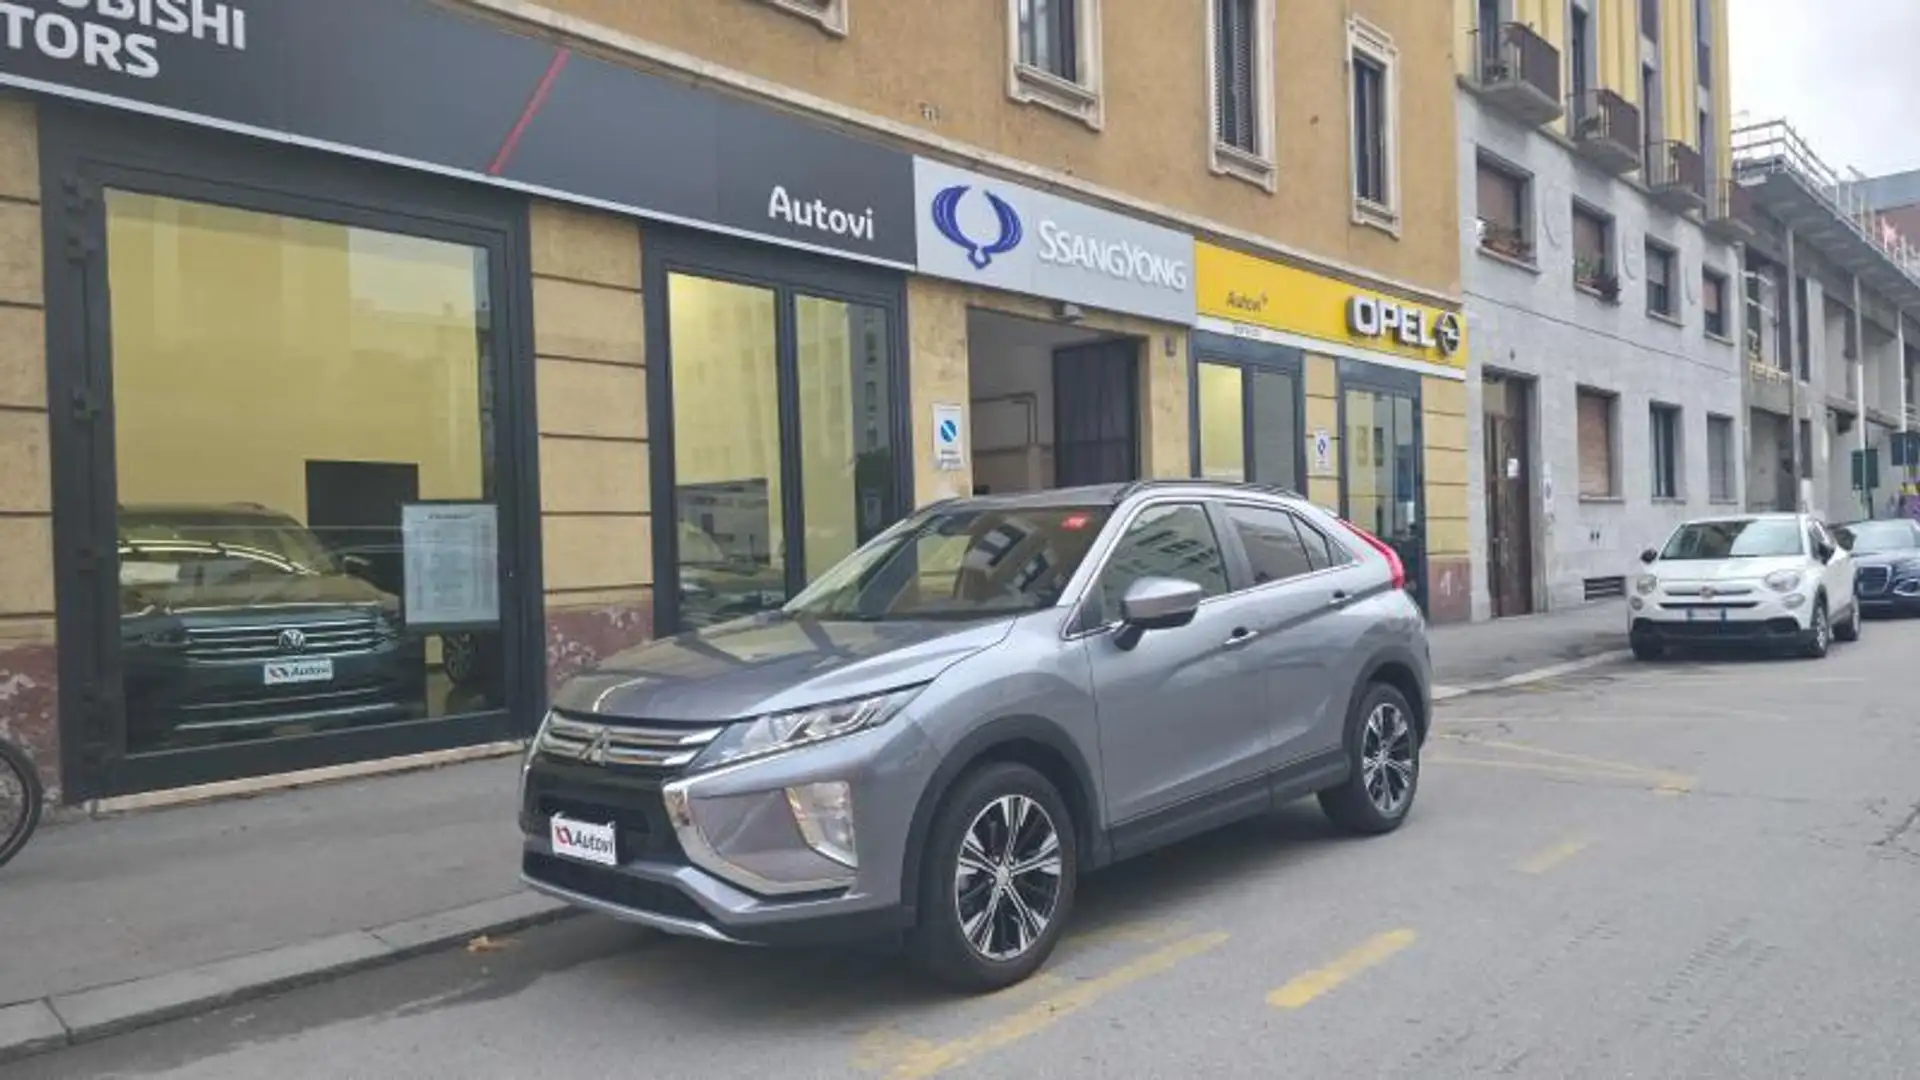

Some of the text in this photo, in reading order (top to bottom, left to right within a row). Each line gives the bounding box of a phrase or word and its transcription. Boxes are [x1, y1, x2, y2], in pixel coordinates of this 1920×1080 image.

[57, 0, 246, 50] ISHI
[769, 184, 874, 240] Autovi
[1347, 295, 1437, 348] OPEL
